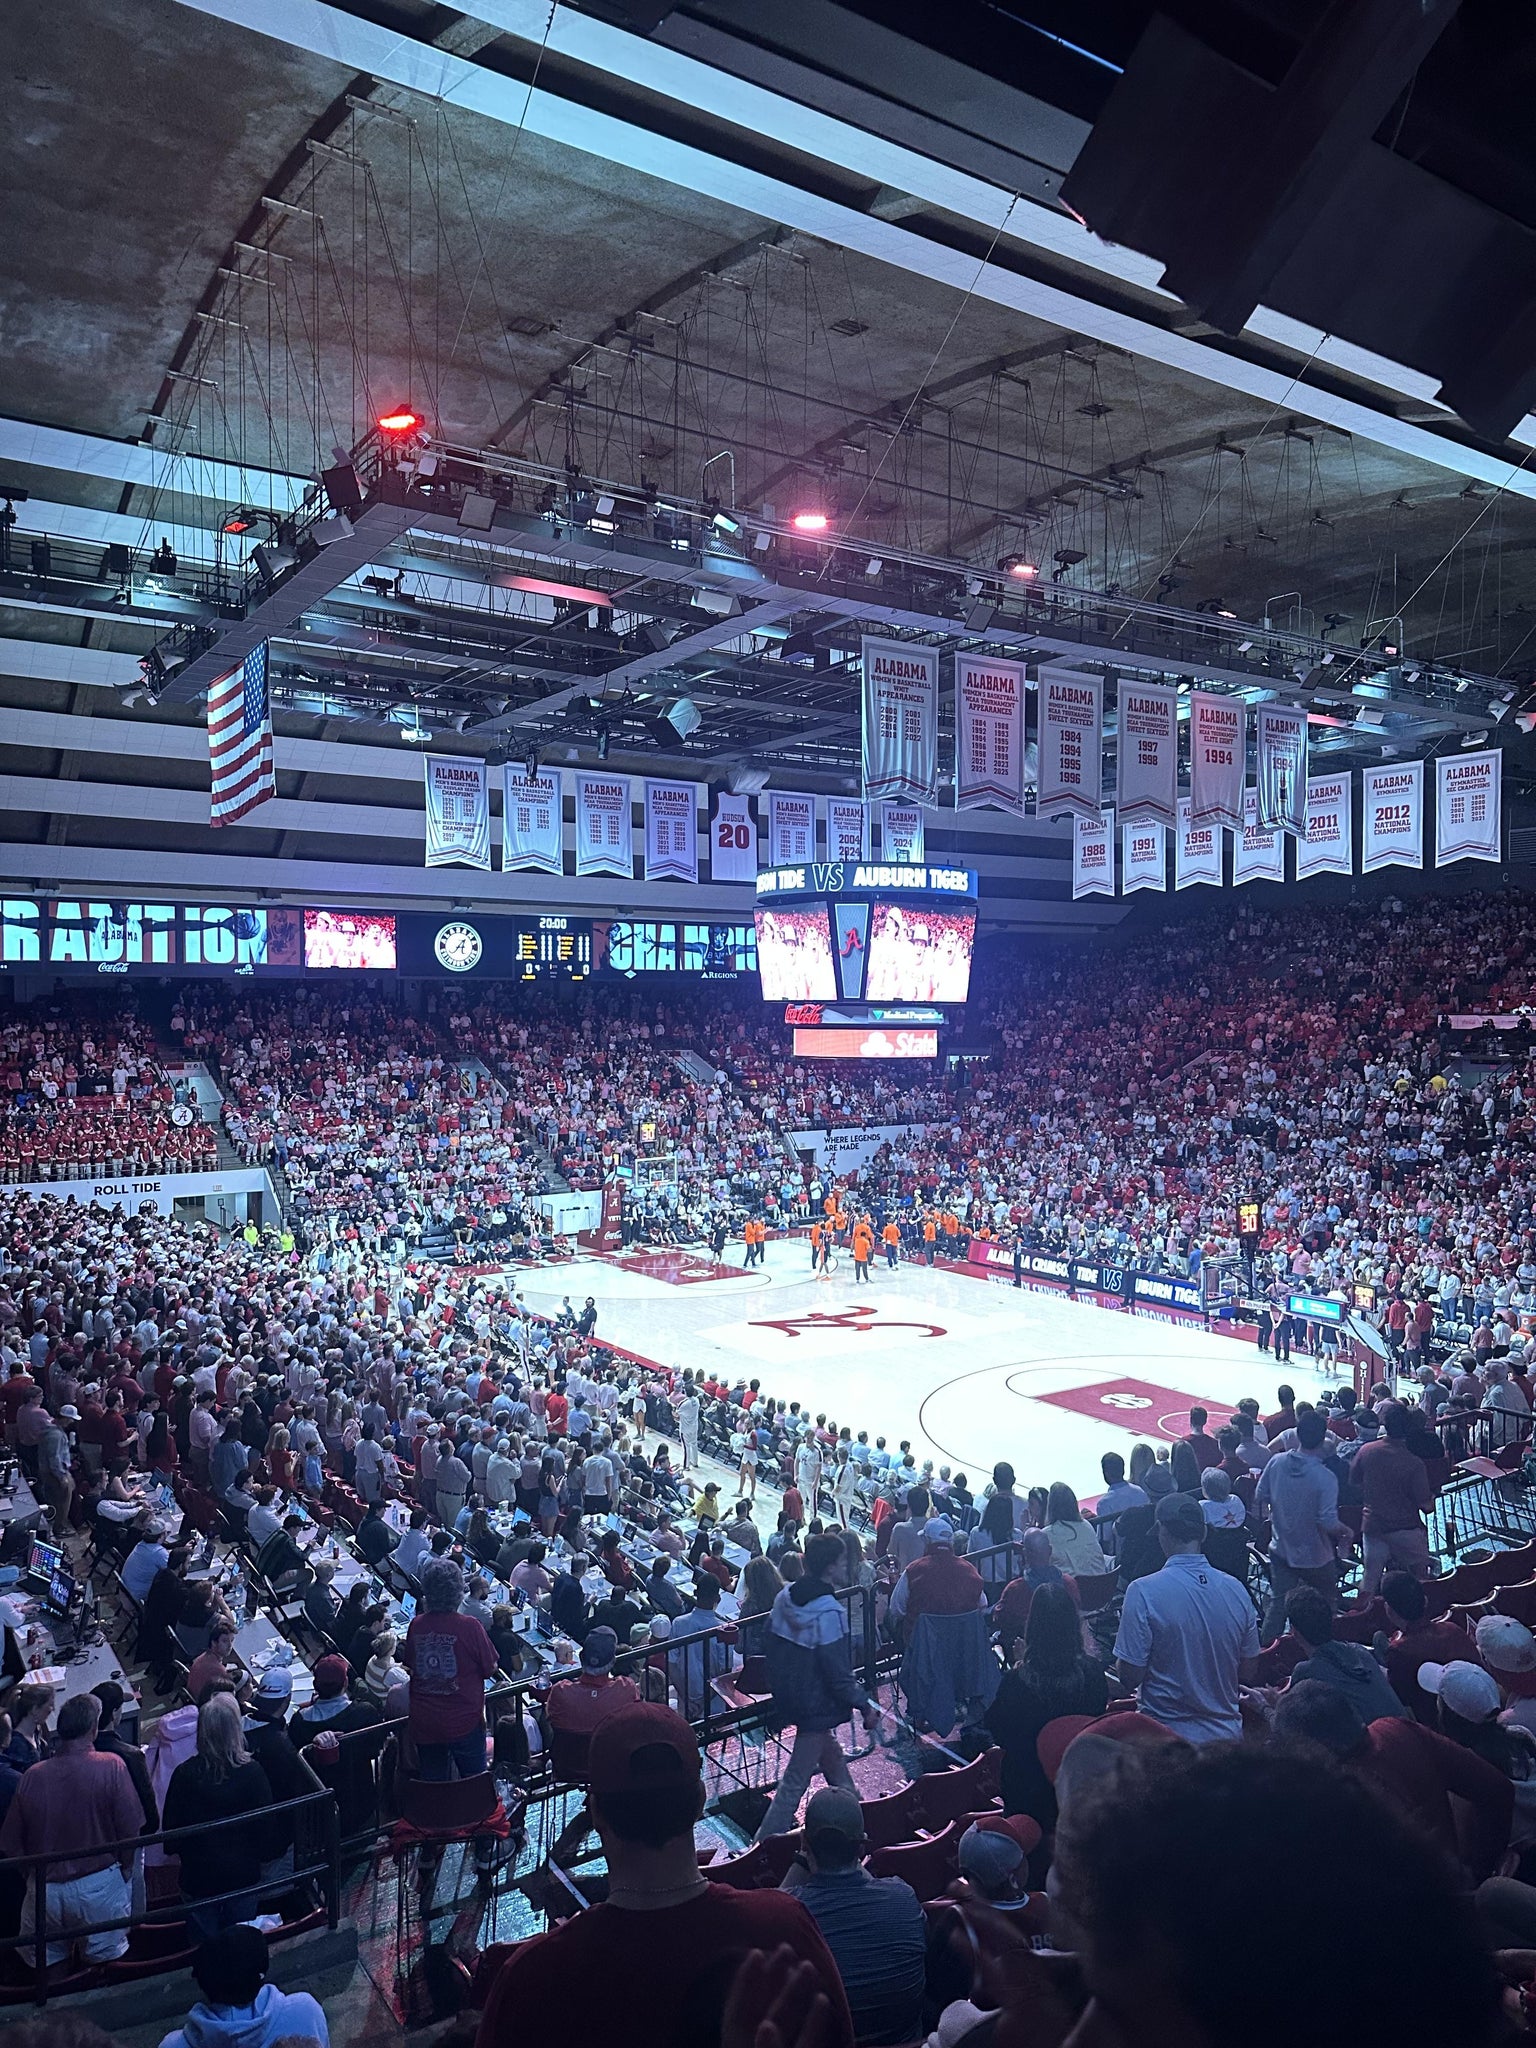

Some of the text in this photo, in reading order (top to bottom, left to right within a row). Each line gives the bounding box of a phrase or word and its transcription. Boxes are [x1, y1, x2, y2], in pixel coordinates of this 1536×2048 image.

[875, 658, 927, 680] ALABAMA
[871, 675, 931, 689] WOMEN'S BASKETBALL
[967, 672, 1014, 693] ALABAMA
[878, 690, 924, 703] APPEARANCES
[963, 688, 1018, 702] WOMEN'S BASKETBALL
[1049, 686, 1093, 705] ALABAMA
[969, 703, 1012, 715] APPEARANCES
[981, 698, 1015, 708] TOURNAMENT
[1068, 705, 1094, 713] BASKETBALL
[1128, 698, 1168, 716] ALABAMA
[905, 710, 920, 718] 2001
[1048, 714, 1093, 726] SWEET SIXTEEN
[1062, 711, 1094, 719] TOURNAMENT
[1200, 709, 1237, 726] ALABAMA
[1140, 721, 1169, 729] TOURNAMENT
[1266, 719, 1300, 735] ALABAMA
[1060, 730, 1081, 743] 1984
[1147, 728, 1169, 736] SIXTEEN
[1060, 744, 1081, 756] 1994
[1138, 740, 1158, 752] 1997
[1138, 754, 1158, 765] 1998
[1205, 749, 1232, 764] 1994
[971, 765, 986, 773] 2024
[1060, 758, 1080, 770] 1995
[1273, 757, 1293, 771] 1994
[436, 768, 479, 782] ALABAMA
[1060, 772, 1080, 784] 1996
[1447, 764, 1490, 780] ALABAMA
[512, 776, 553, 789] ALABAMA
[1373, 775, 1413, 789] ALABAMA
[1451, 778, 1486, 786] GYMNASTICS
[1458, 782, 1490, 791] CHAMPIONS
[585, 784, 623, 796] ALABAMA
[1377, 787, 1409, 796] GYMNASTICS
[653, 790, 689, 803] ALABAMA
[1309, 797, 1338, 806] GYMNASTICS
[776, 802, 809, 813] ALABAMA
[834, 807, 864, 818] ALABAMA
[1376, 805, 1410, 821] 2012
[722, 813, 745, 822] HUDSON
[888, 812, 917, 823] ALABAMA
[1309, 814, 1338, 830] 2011
[1375, 820, 1411, 829] NATIONAL
[719, 823, 749, 849] 20
[1307, 828, 1340, 837] NATIONAL
[1374, 827, 1411, 835] CHAMPIONS
[839, 834, 860, 845] 2004
[894, 838, 912, 847] 2024
[1185, 831, 1212, 844] 1996
[1243, 837, 1274, 845] NATIONAL
[1307, 835, 1340, 844] CHAMPIONS
[1083, 844, 1105, 857] 1988
[1133, 838, 1155, 851] 1991
[1184, 843, 1213, 852] NATIONAL
[1243, 843, 1274, 851] CHAMPIONS
[839, 847, 860, 856] 2024
[778, 869, 805, 890] TIDE
[812, 863, 844, 891] VS
[853, 867, 926, 888] AUBURN
[929, 869, 968, 891] TIGERS
[539, 917, 567, 929] 20:00
[0, 900, 268, 964] RADITION
[440, 927, 477, 945] ALABAMA
[450, 939, 466, 954] A
[839, 927, 862, 954] A
[98, 962, 130, 973] Coca-Cola
[526, 963, 589, 975] 0 0
[785, 1004, 824, 1024] Coca-Cola
[176, 1108, 189, 1121] A
[642, 1131, 655, 1140] 30
[824, 1134, 880, 1144] WHERE LEGENDS
[824, 1144, 838, 1152] ARE
[825, 1153, 836, 1166] A
[94, 1182, 161, 1196] ROLL TIDE
[610, 1198, 618, 1207] A
[1242, 1215, 1257, 1232] 30
[1032, 1257, 1076, 1278] CRIMSO
[1076, 1266, 1099, 1283] TIDE
[1103, 1268, 1122, 1291] VS
[1135, 1278, 1173, 1299] UBURN
[1175, 1286, 1200, 1306] TIGE
[1357, 1296, 1369, 1308] 30
